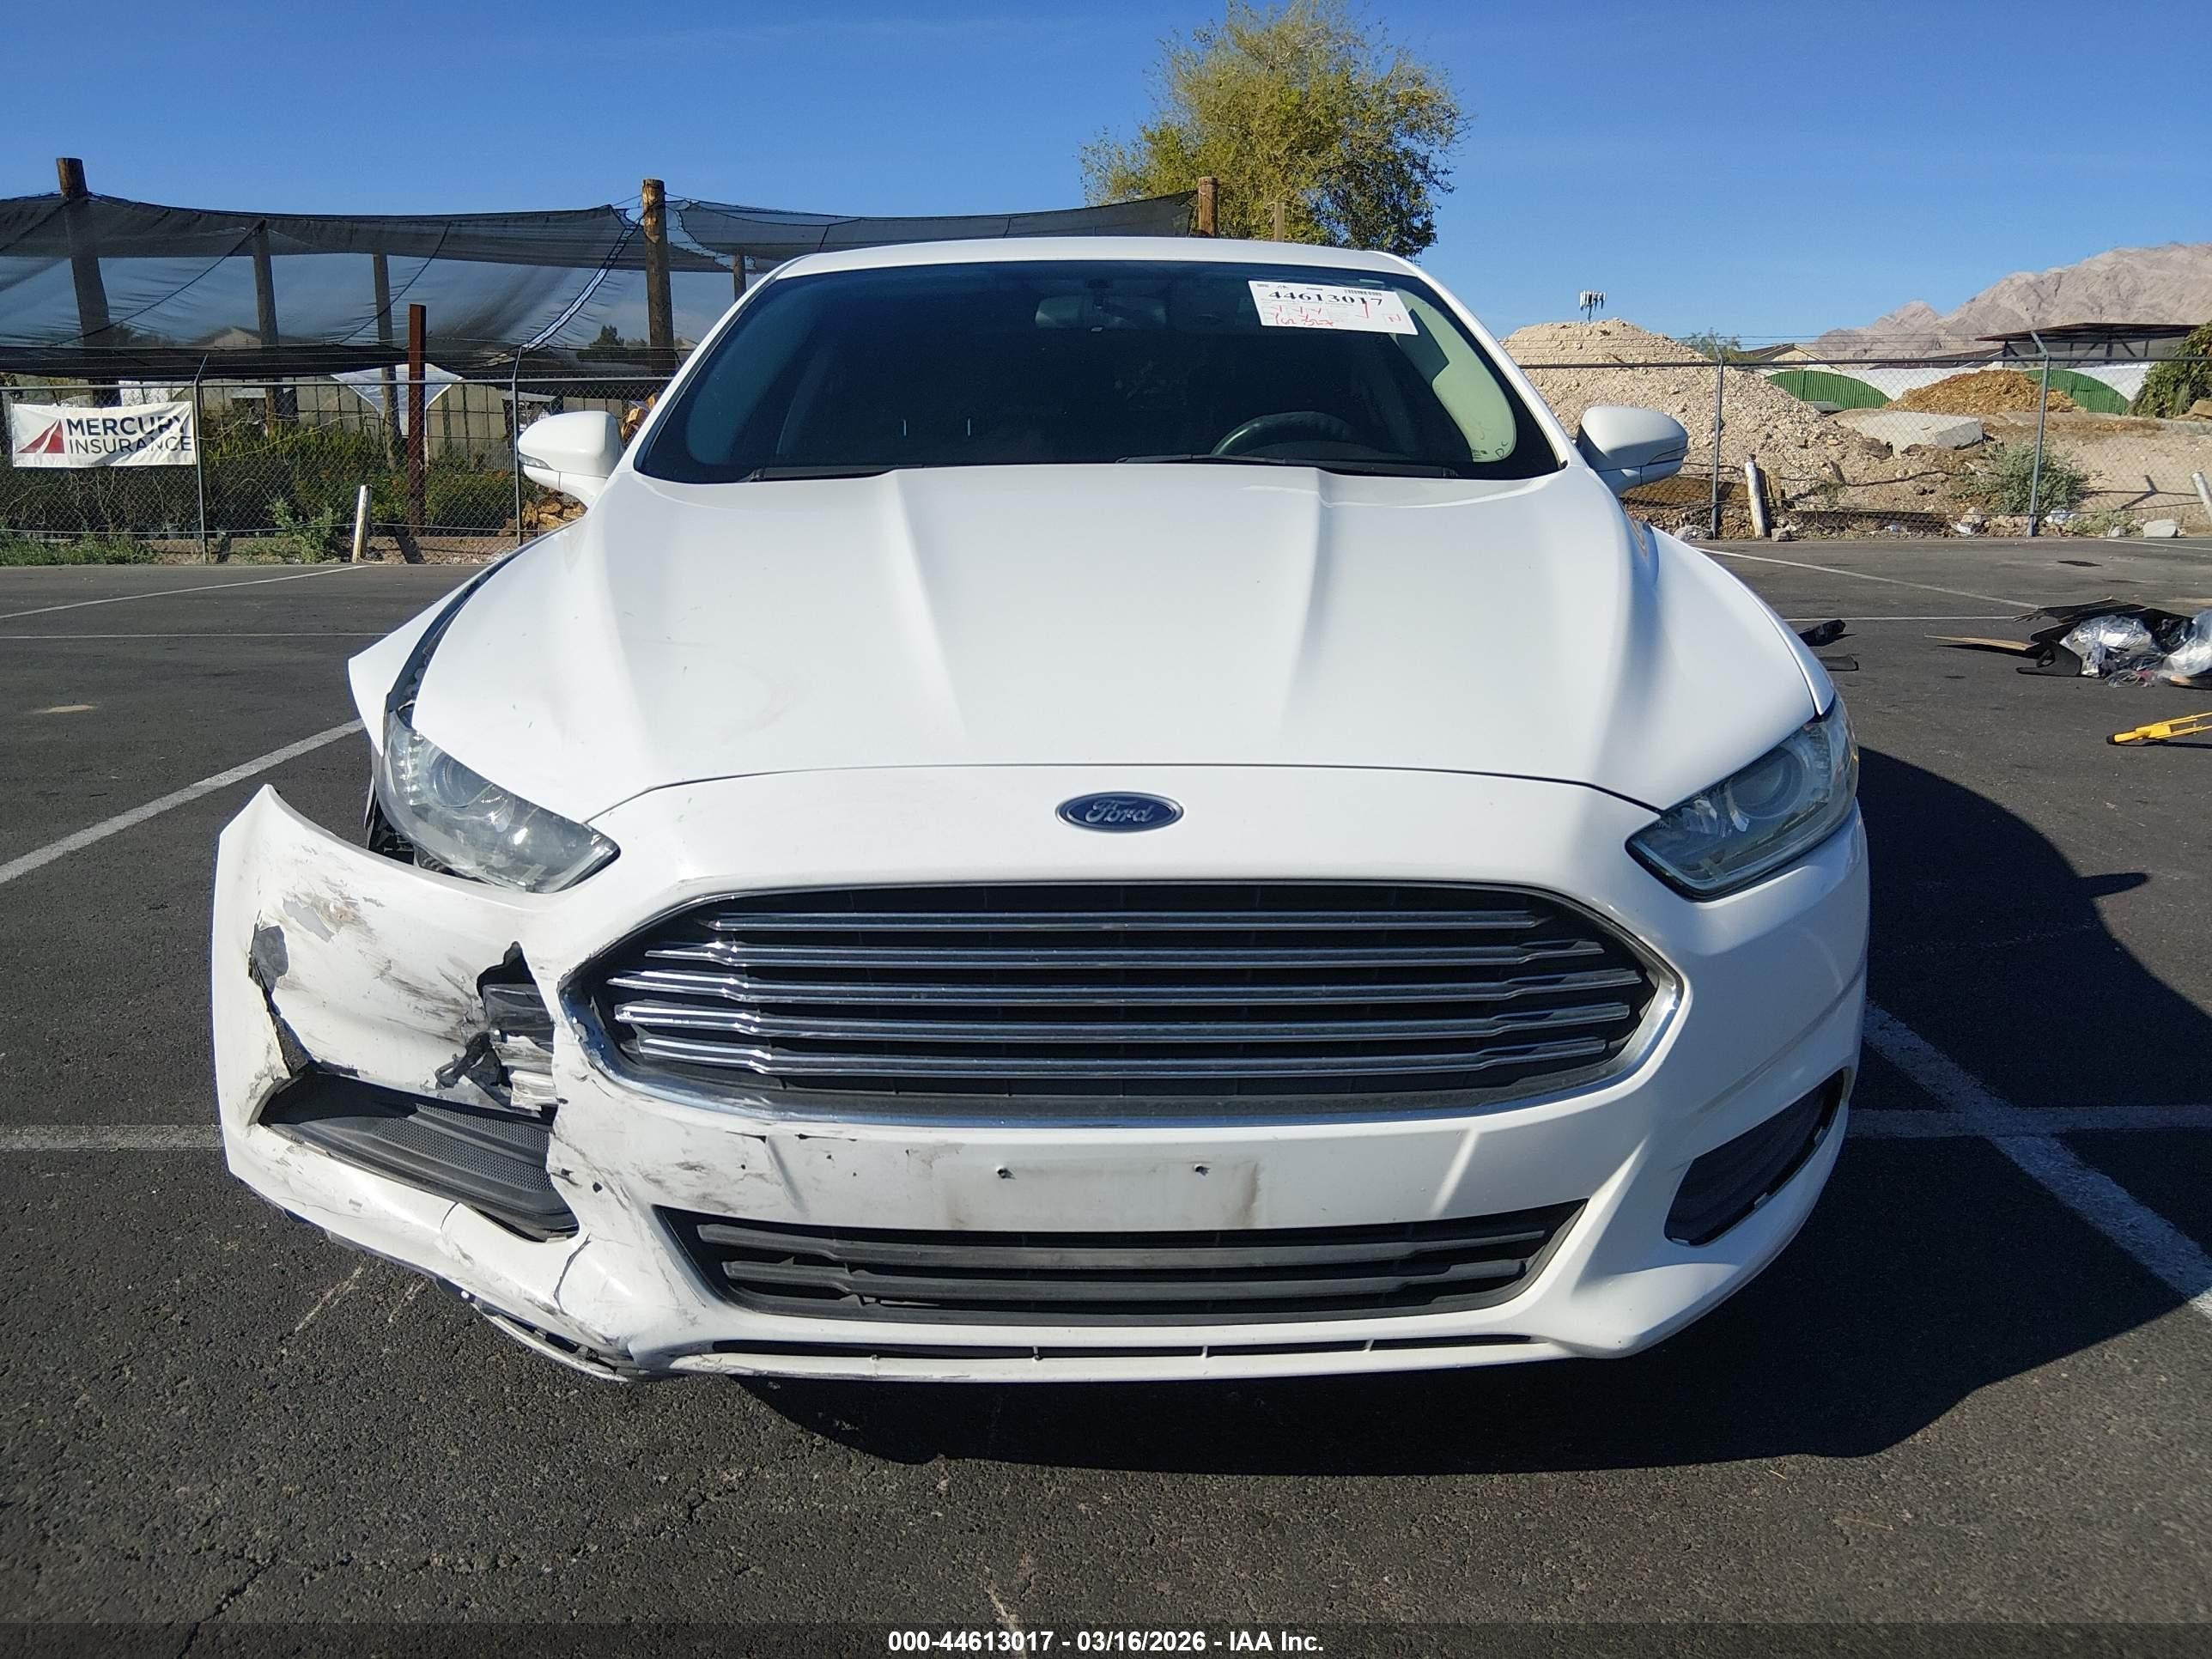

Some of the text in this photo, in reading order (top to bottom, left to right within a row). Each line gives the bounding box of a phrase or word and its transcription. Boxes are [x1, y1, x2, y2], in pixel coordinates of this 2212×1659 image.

[1268, 290, 1383, 307] 44613017
[67, 416, 185, 436] MERCURY
[69, 436, 192, 455] INSURANCE
[1085, 799, 1154, 823] Ford
